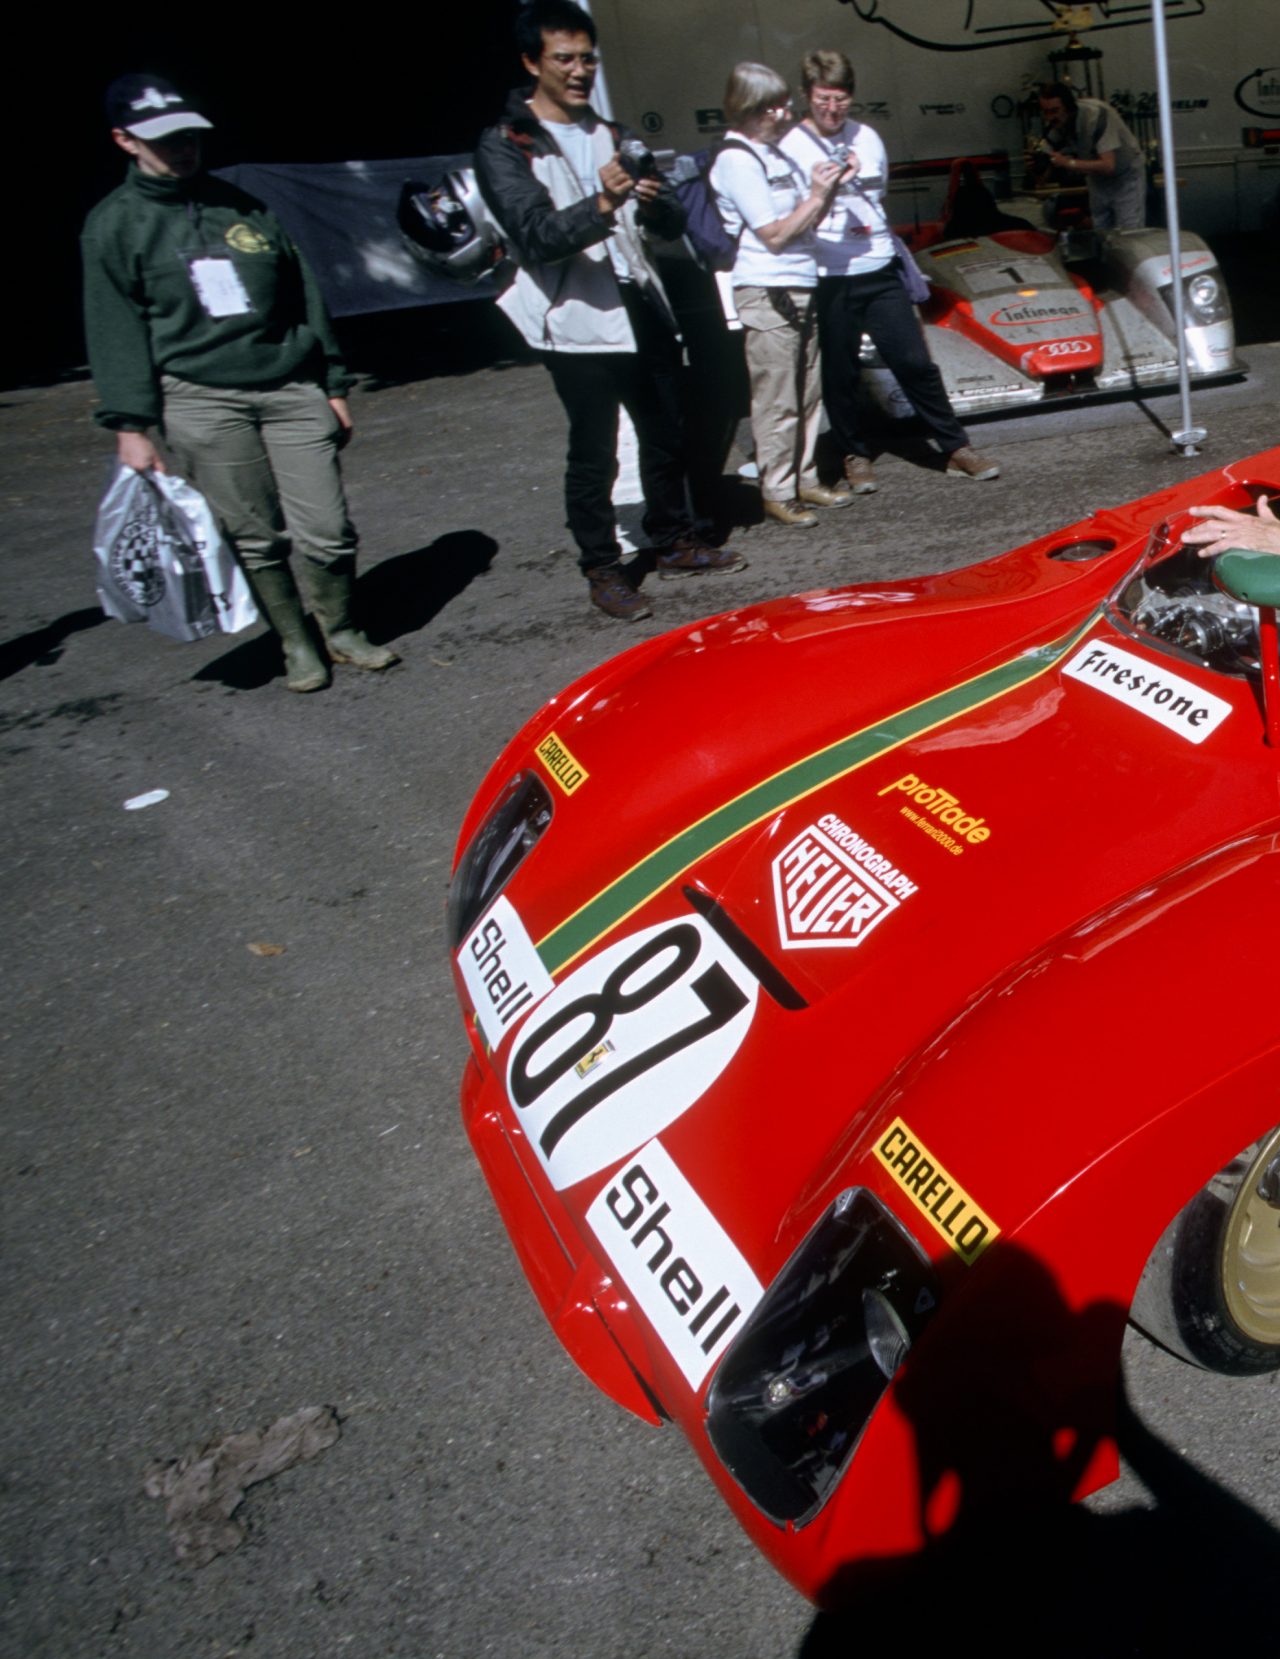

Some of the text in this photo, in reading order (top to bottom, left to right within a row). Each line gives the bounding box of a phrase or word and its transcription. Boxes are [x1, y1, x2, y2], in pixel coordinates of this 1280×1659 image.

[998, 267, 1024, 284] 1
[1077, 649, 1209, 727] Firestone
[539, 735, 583, 790] CARELLO
[877, 773, 991, 844] proTrade
[784, 838, 883, 934] HEUER
[817, 813, 919, 900] CHRONOGRAPH
[470, 917, 534, 1026] Shell
[509, 922, 751, 1162] 87
[879, 1127, 990, 1256] CARELLO
[605, 1164, 742, 1356] Shell
